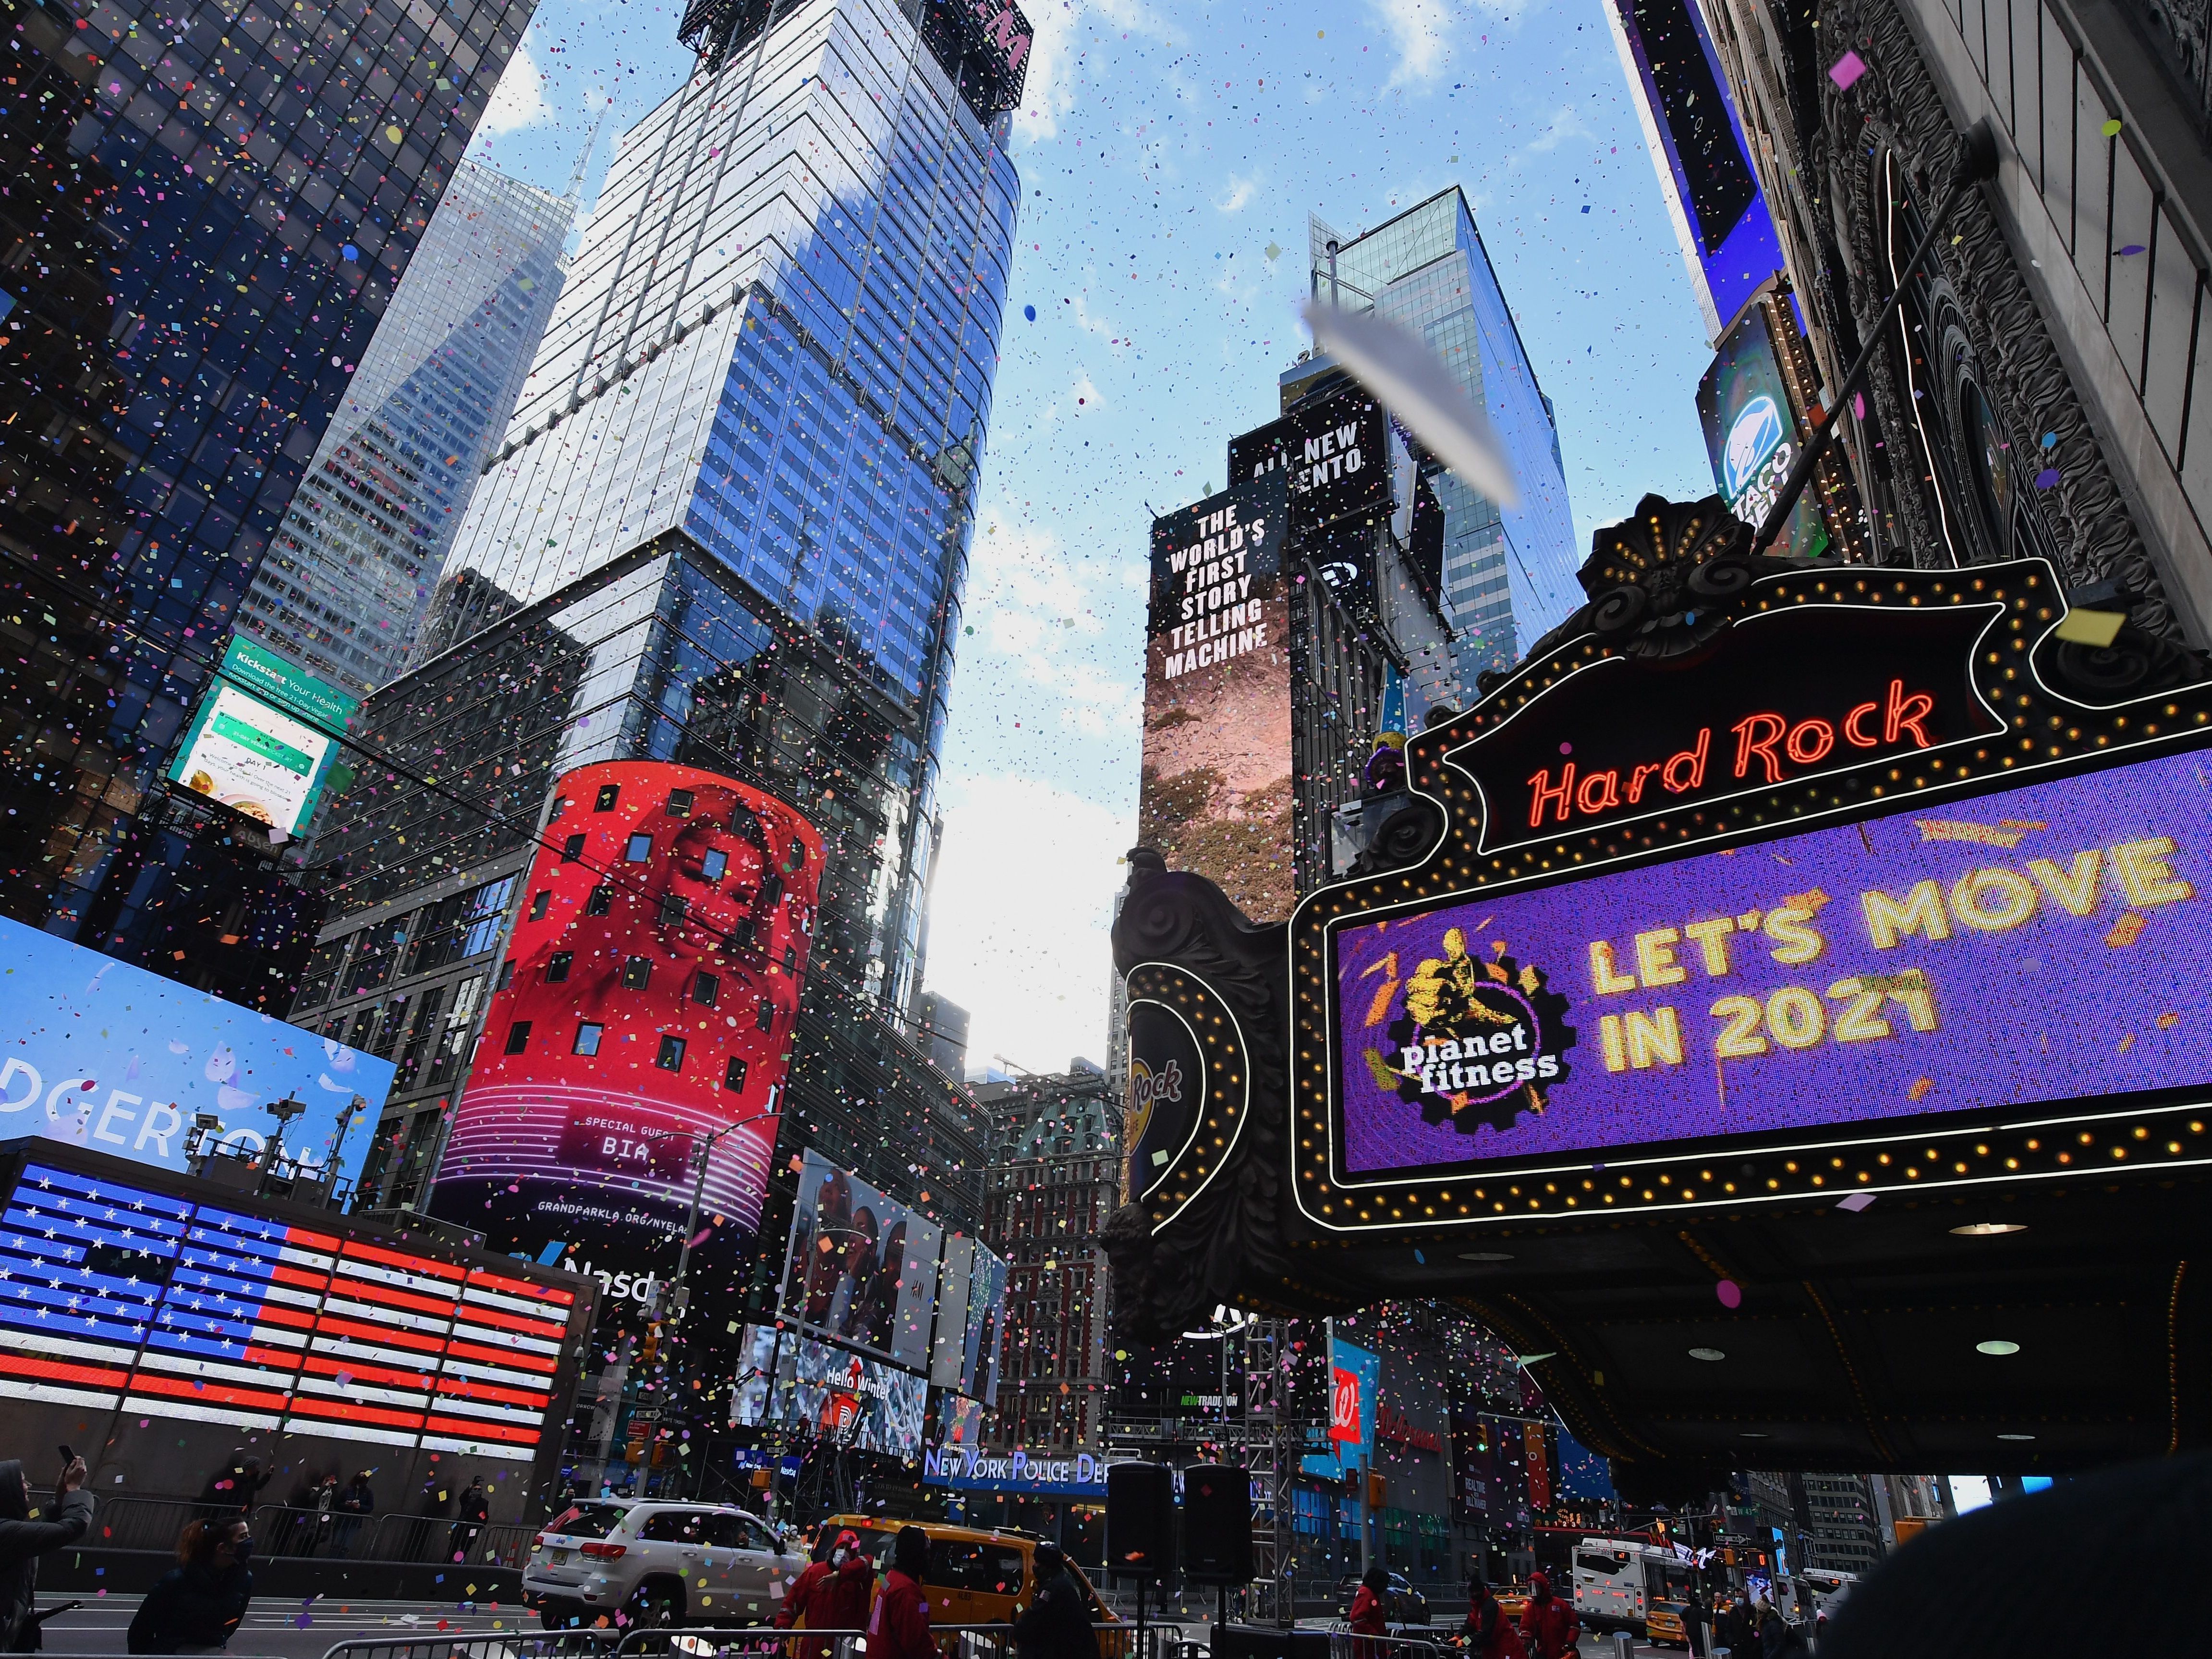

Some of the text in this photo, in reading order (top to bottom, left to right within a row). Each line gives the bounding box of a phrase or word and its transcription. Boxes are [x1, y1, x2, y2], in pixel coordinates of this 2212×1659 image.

[1730, 442, 1791, 522] TACO
[1198, 505, 1237, 537] THE
[1170, 519, 1265, 573] WORLD'S
[1186, 550, 1248, 593] FIRST
[1181, 574, 1252, 620] STORY
[1171, 598, 1262, 650] TELLING
[1165, 623, 1267, 679] MACHINE
[232, 664, 264, 684] Download
[264, 681, 276, 690] the
[289, 695, 310, 709] 21-Day
[236, 652, 342, 715] Kickstat Your Health
[292, 705, 301, 713] up
[246, 757, 261, 768] DAY
[1528, 679, 1936, 827] Hard Rock
[1589, 836, 2198, 995] LET'S MOVE
[1598, 968, 1941, 1073] IN 2021
[1400, 1023, 1528, 1074] planet
[1131, 1059, 1183, 1114] Rock
[1420, 1054, 1559, 1093] fitness
[585, 1117, 636, 1134] SPECIAL
[602, 1136, 649, 1160] BIA
[826, 1366, 892, 1401] Hello Winter
[924, 1448, 962, 1476] NEW
[966, 1450, 1008, 1479] YORK
[1012, 1451, 1070, 1482] POLICE
